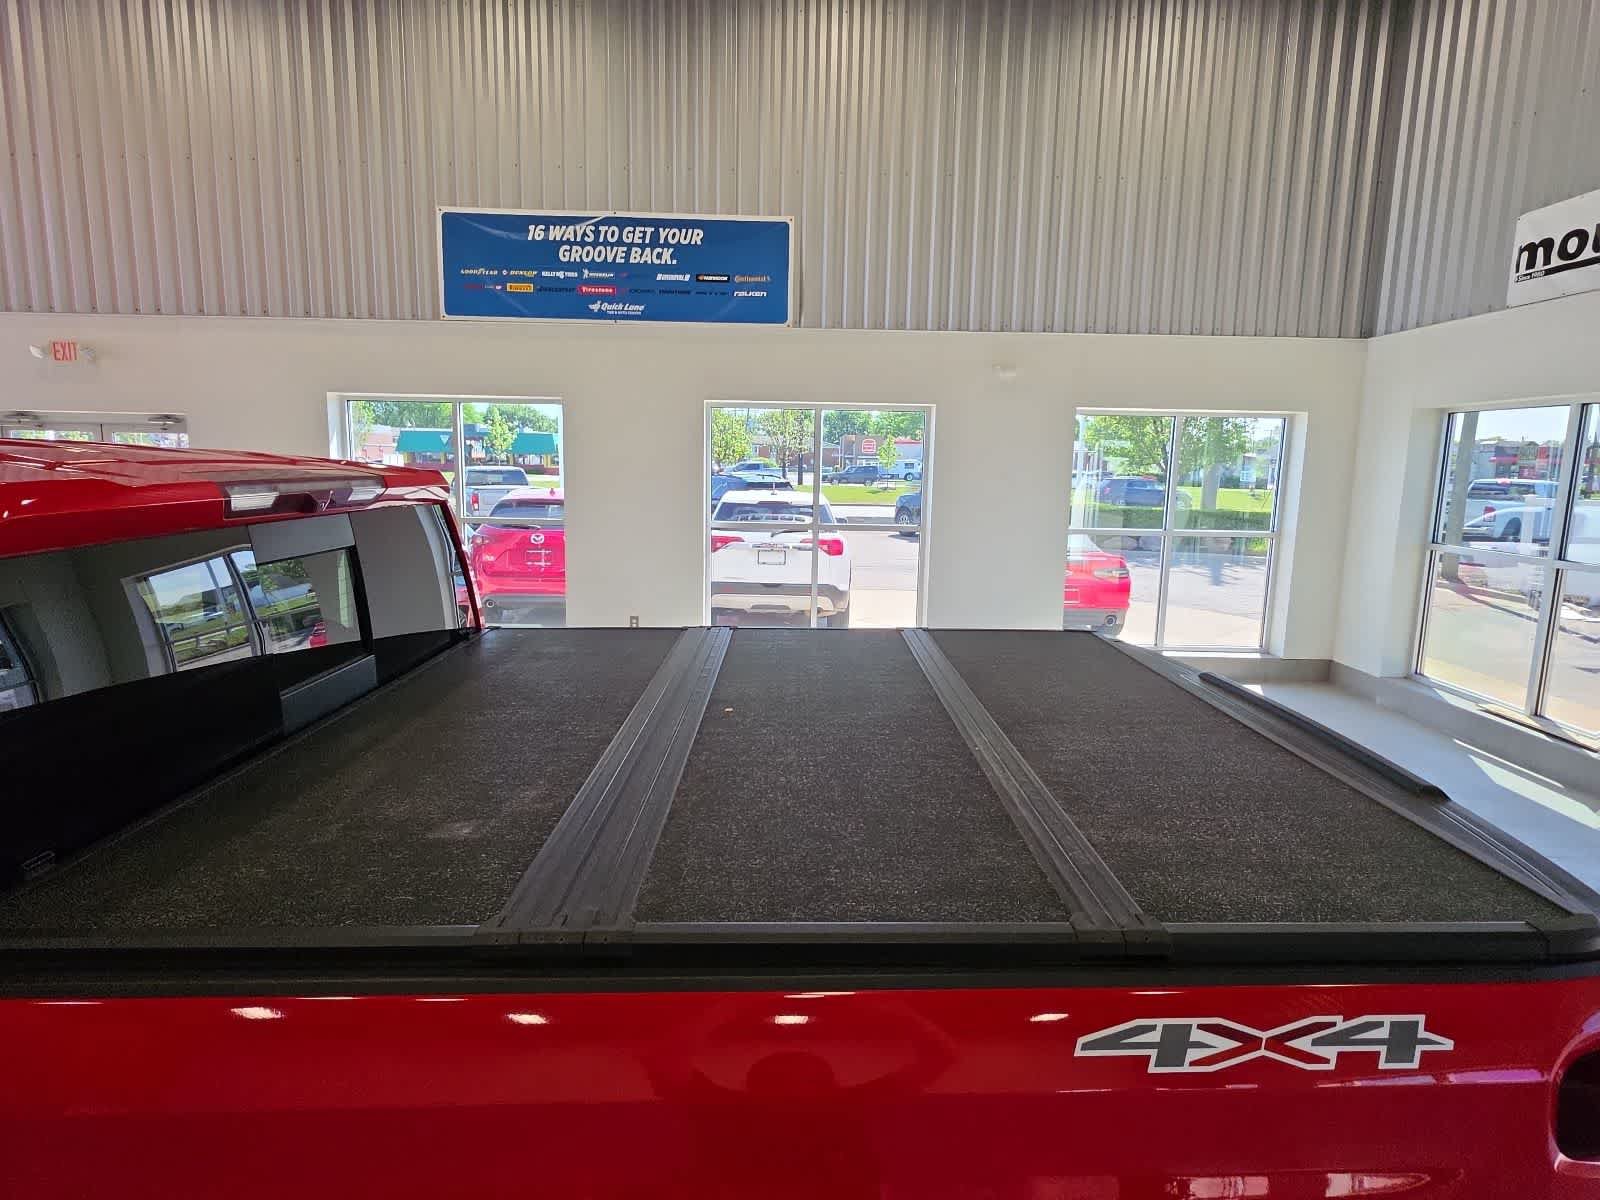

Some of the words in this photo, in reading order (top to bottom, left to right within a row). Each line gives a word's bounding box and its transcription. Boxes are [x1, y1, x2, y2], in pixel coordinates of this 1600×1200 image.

[527, 224, 546, 241] 16
[548, 225, 596, 243] WAYS
[598, 225, 620, 243] TO
[622, 226, 655, 244] GET
[658, 227, 704, 246] YOUR
[558, 244, 627, 264] GROOVE
[629, 246, 678, 265] BACK.
[600, 302, 624, 312] Quick
[624, 303, 645, 311] Lane
[52, 341, 77, 361] EXIT
